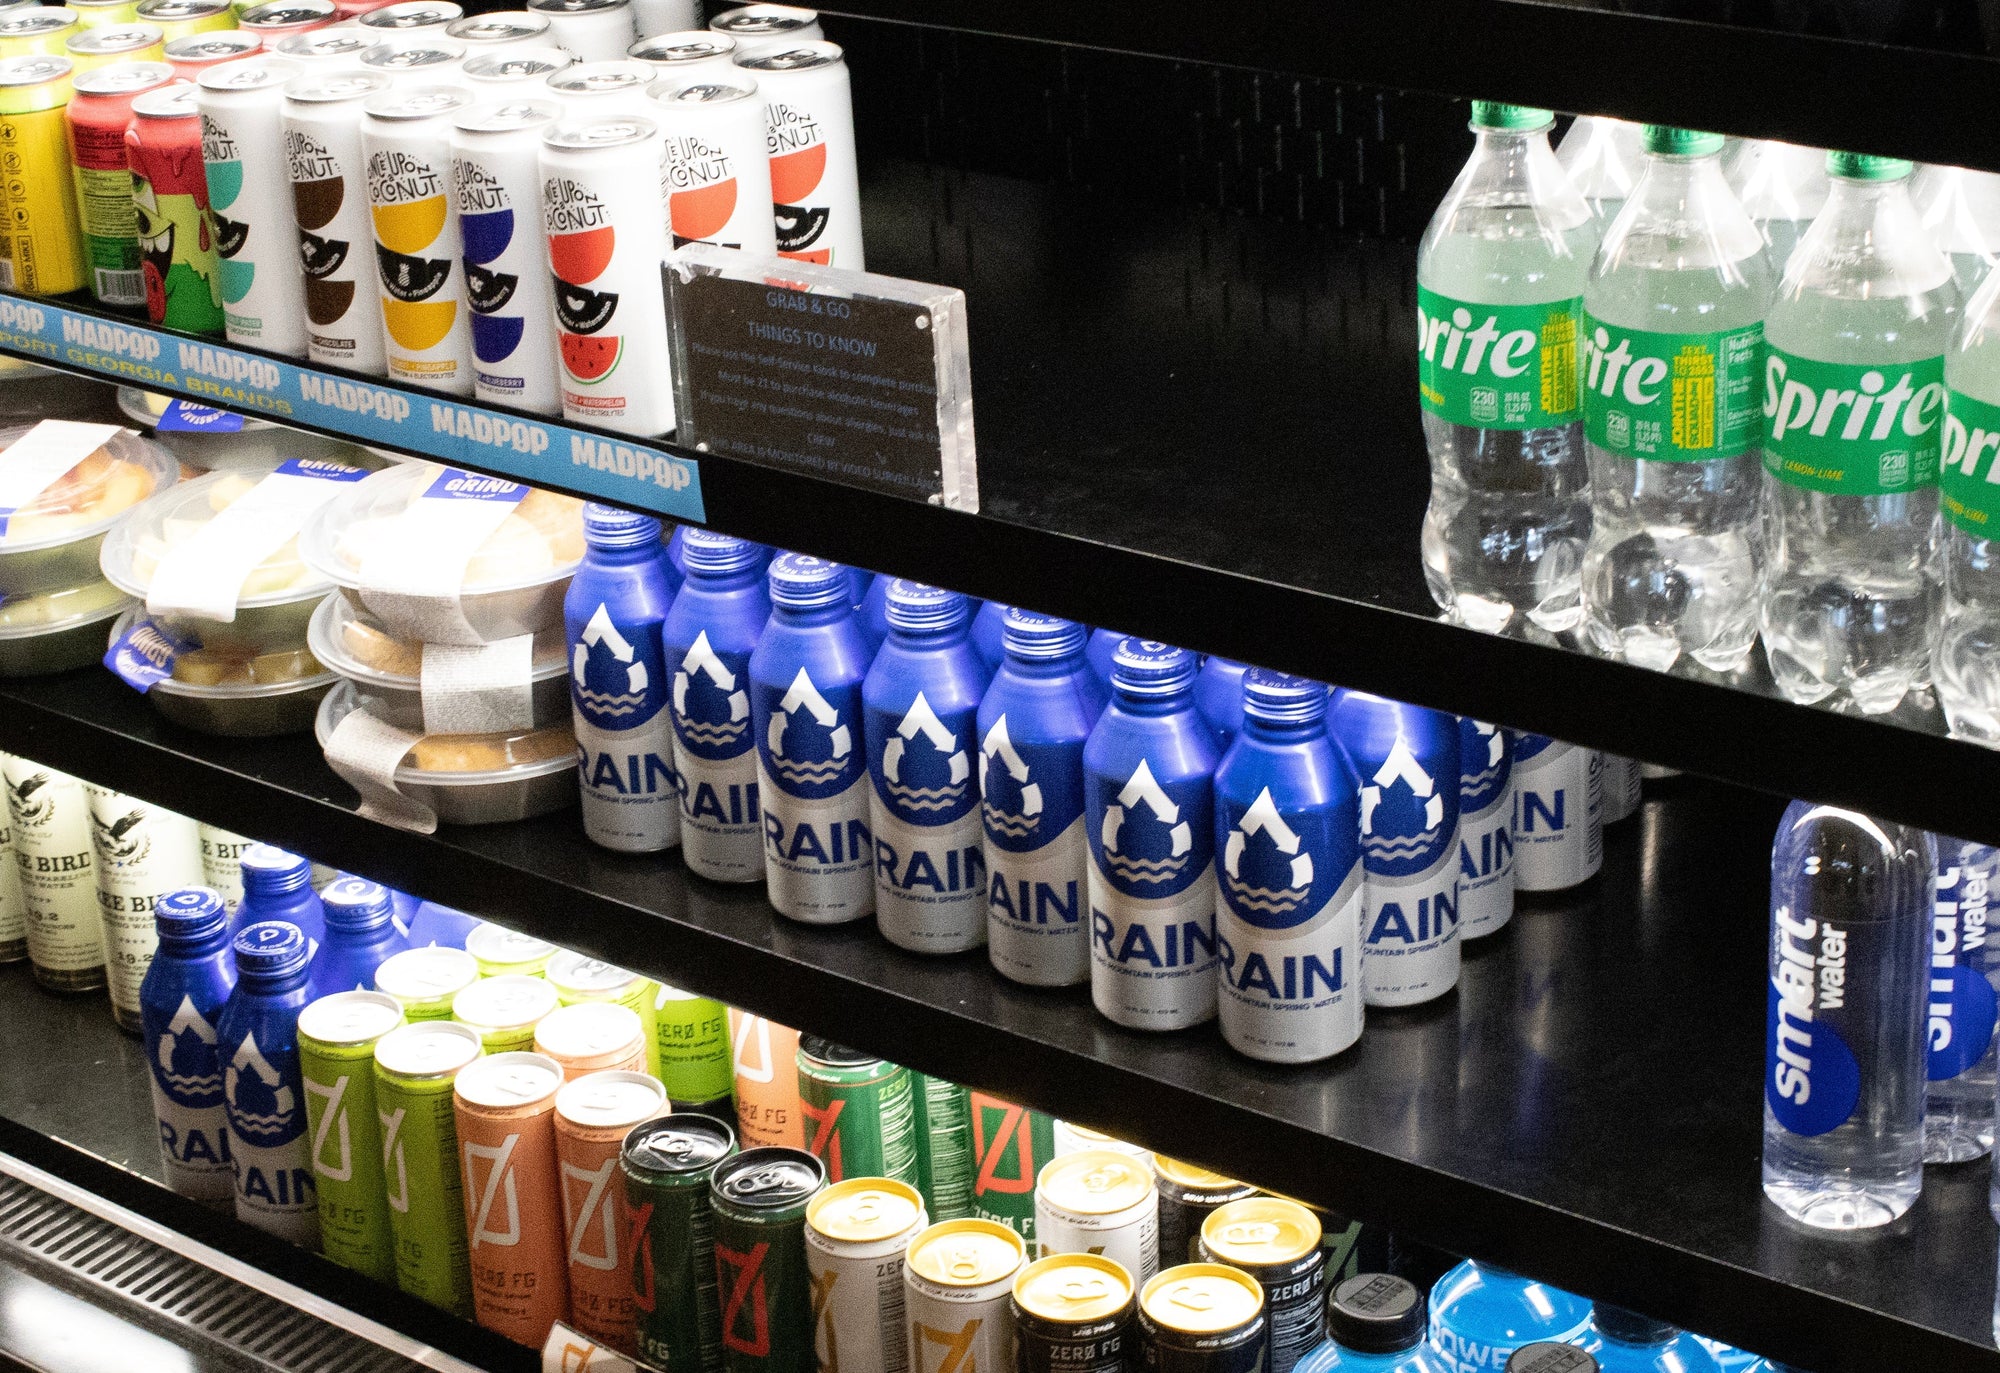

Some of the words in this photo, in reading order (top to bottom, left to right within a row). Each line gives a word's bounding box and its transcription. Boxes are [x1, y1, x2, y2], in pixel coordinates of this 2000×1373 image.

[387, 151, 431, 176] UPON
[766, 290, 807, 312] GRAB
[810, 298, 824, 314] &
[826, 301, 850, 319] GO
[747, 321, 801, 346] THINGS
[804, 331, 824, 349] TO
[828, 335, 878, 358] KNOW
[67, 349, 178, 385] GEORGIA
[185, 378, 294, 415] BRANDS
[1763, 354, 1944, 442] Sprite
[444, 477, 521, 494] GRIND
[841, 462, 872, 478] VIDEO
[989, 871, 1080, 925] AIN
[1366, 880, 1459, 944] AIN
[1959, 864, 1990, 952] water
[1154, 970, 1192, 980] SPRING
[1218, 936, 1344, 1000] RAIN
[1816, 922, 1848, 1010] water
[1273, 1000, 1311, 1012] SPRING
[1314, 995, 1344, 1009] WATER
[1101, 1336, 1122, 1357] FG
